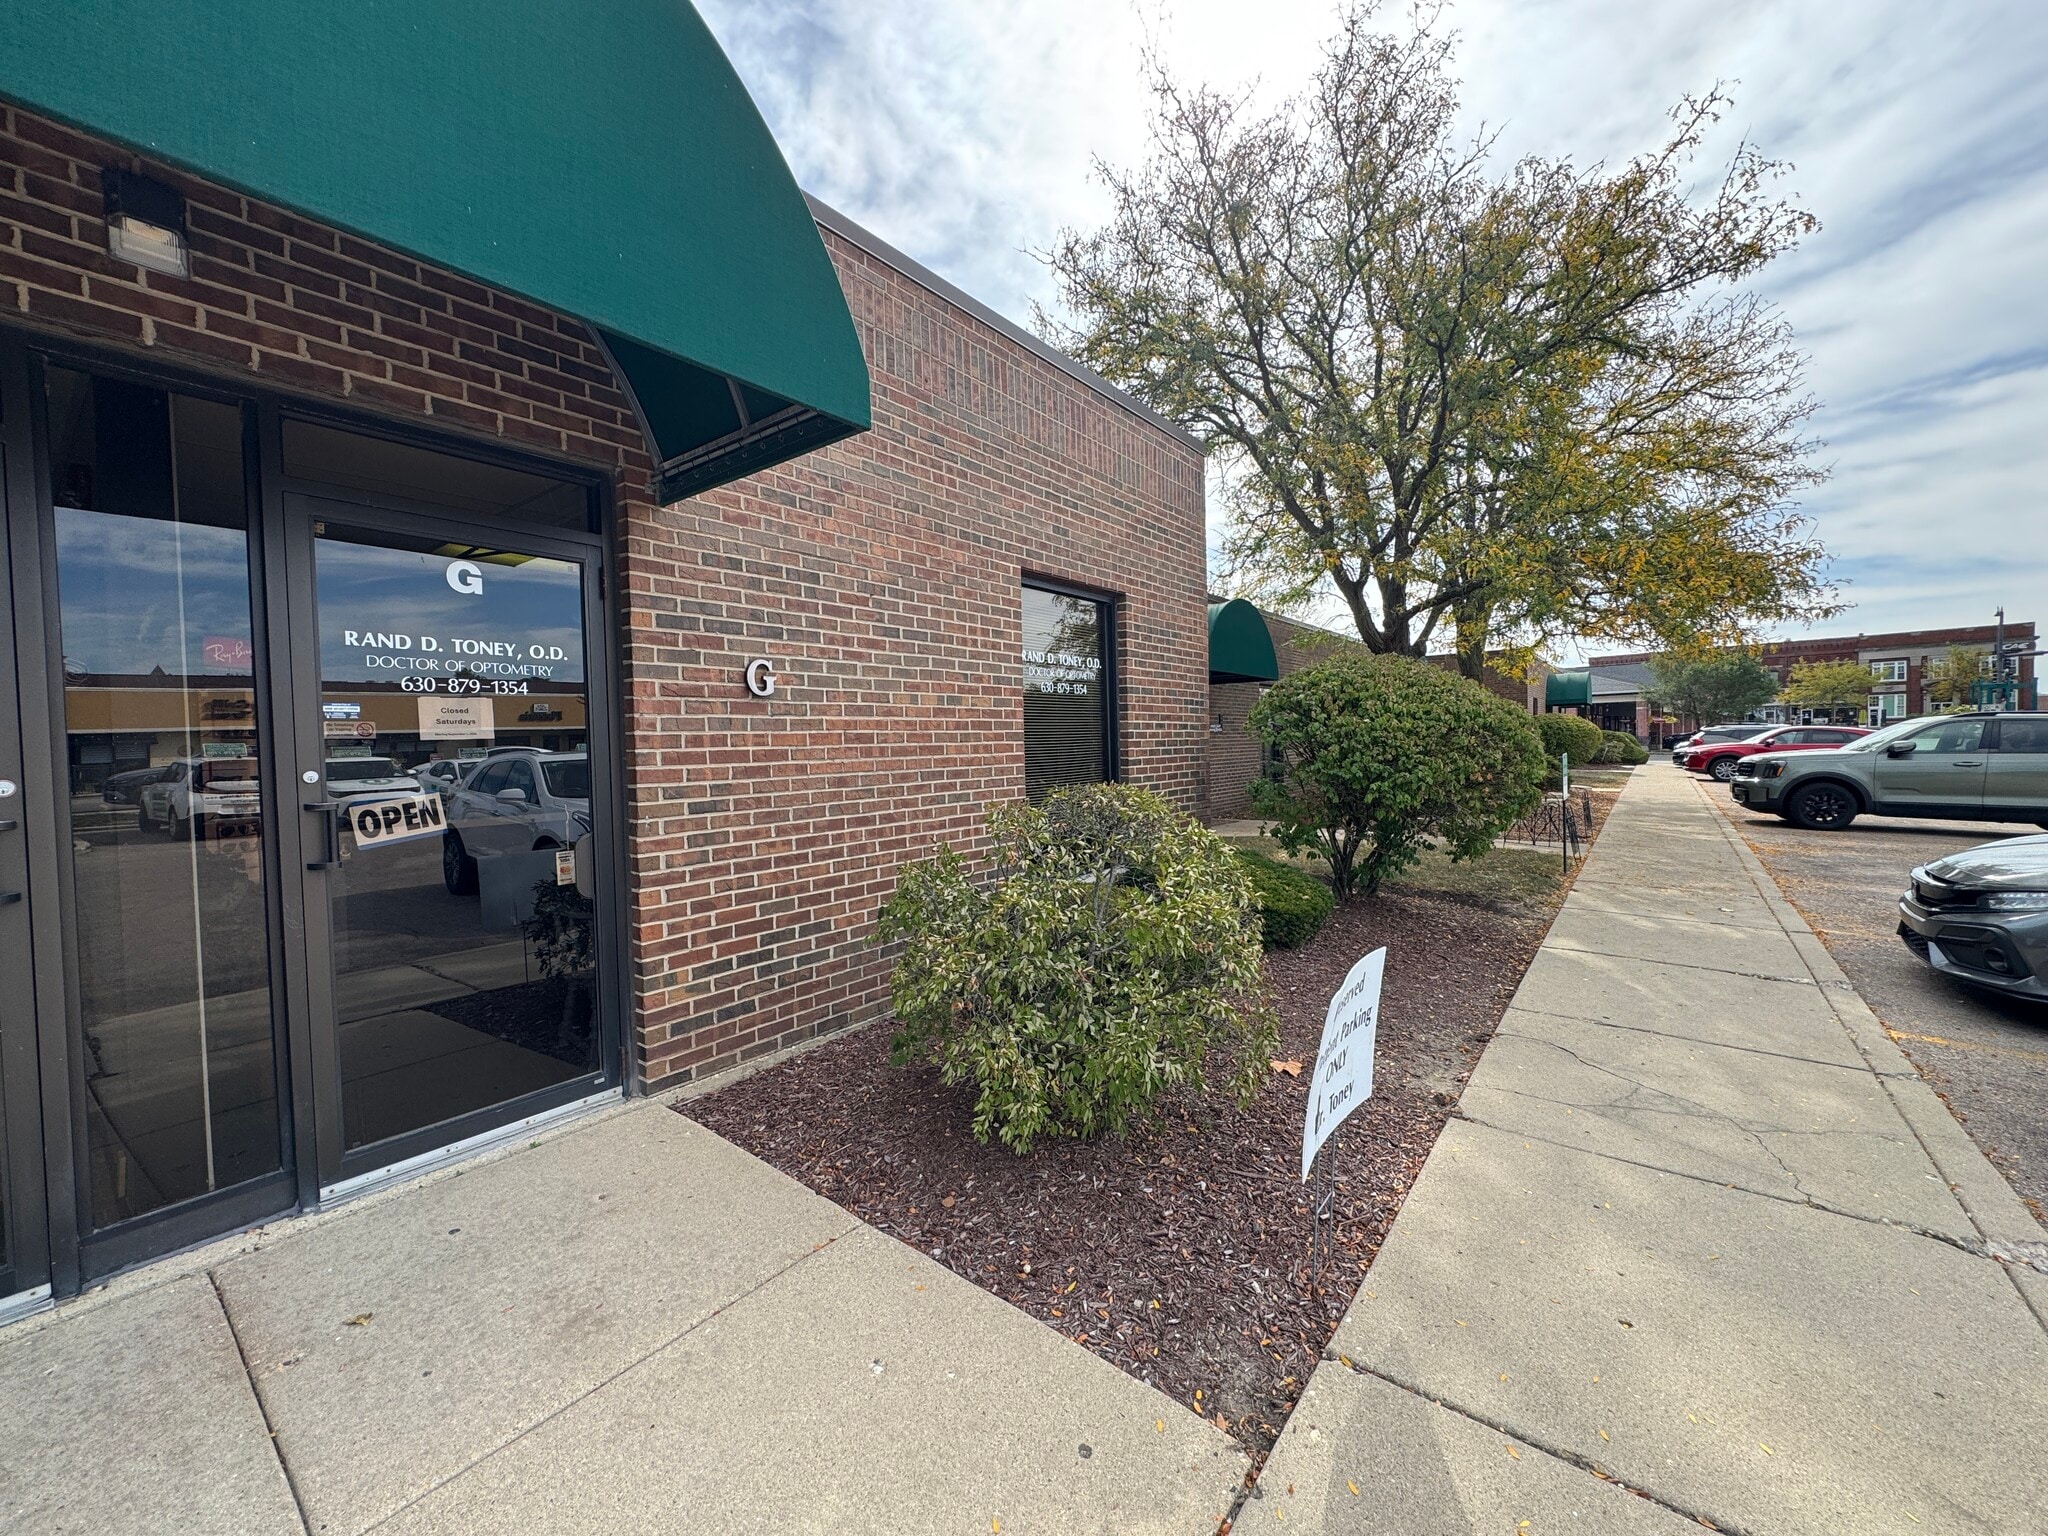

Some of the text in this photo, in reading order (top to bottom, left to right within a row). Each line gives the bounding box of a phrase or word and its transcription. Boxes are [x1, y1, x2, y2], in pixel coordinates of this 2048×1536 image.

[446, 560, 483, 595] G
[206, 641, 252, 662] Ray-Ba
[344, 630, 568, 661] RAND D. TONEY, O.D.
[366, 654, 554, 677] DOCTOR OF OPTOMETRY
[1022, 650, 1102, 669] RAND D. TONEY, O.D.
[401, 676, 529, 695] 630-879-1354
[747, 659, 777, 696] G
[1028, 667, 1097, 680] DOCTOR OF OPTOMETRY
[1040, 682, 1088, 695] 630-879-1354
[435, 718, 476, 726] Saturdays
[358, 798, 441, 838] OPEN
[1341, 1007, 1373, 1042] Parking
[1325, 1046, 1349, 1083] ONLY
[1329, 1079, 1355, 1114] Toney
